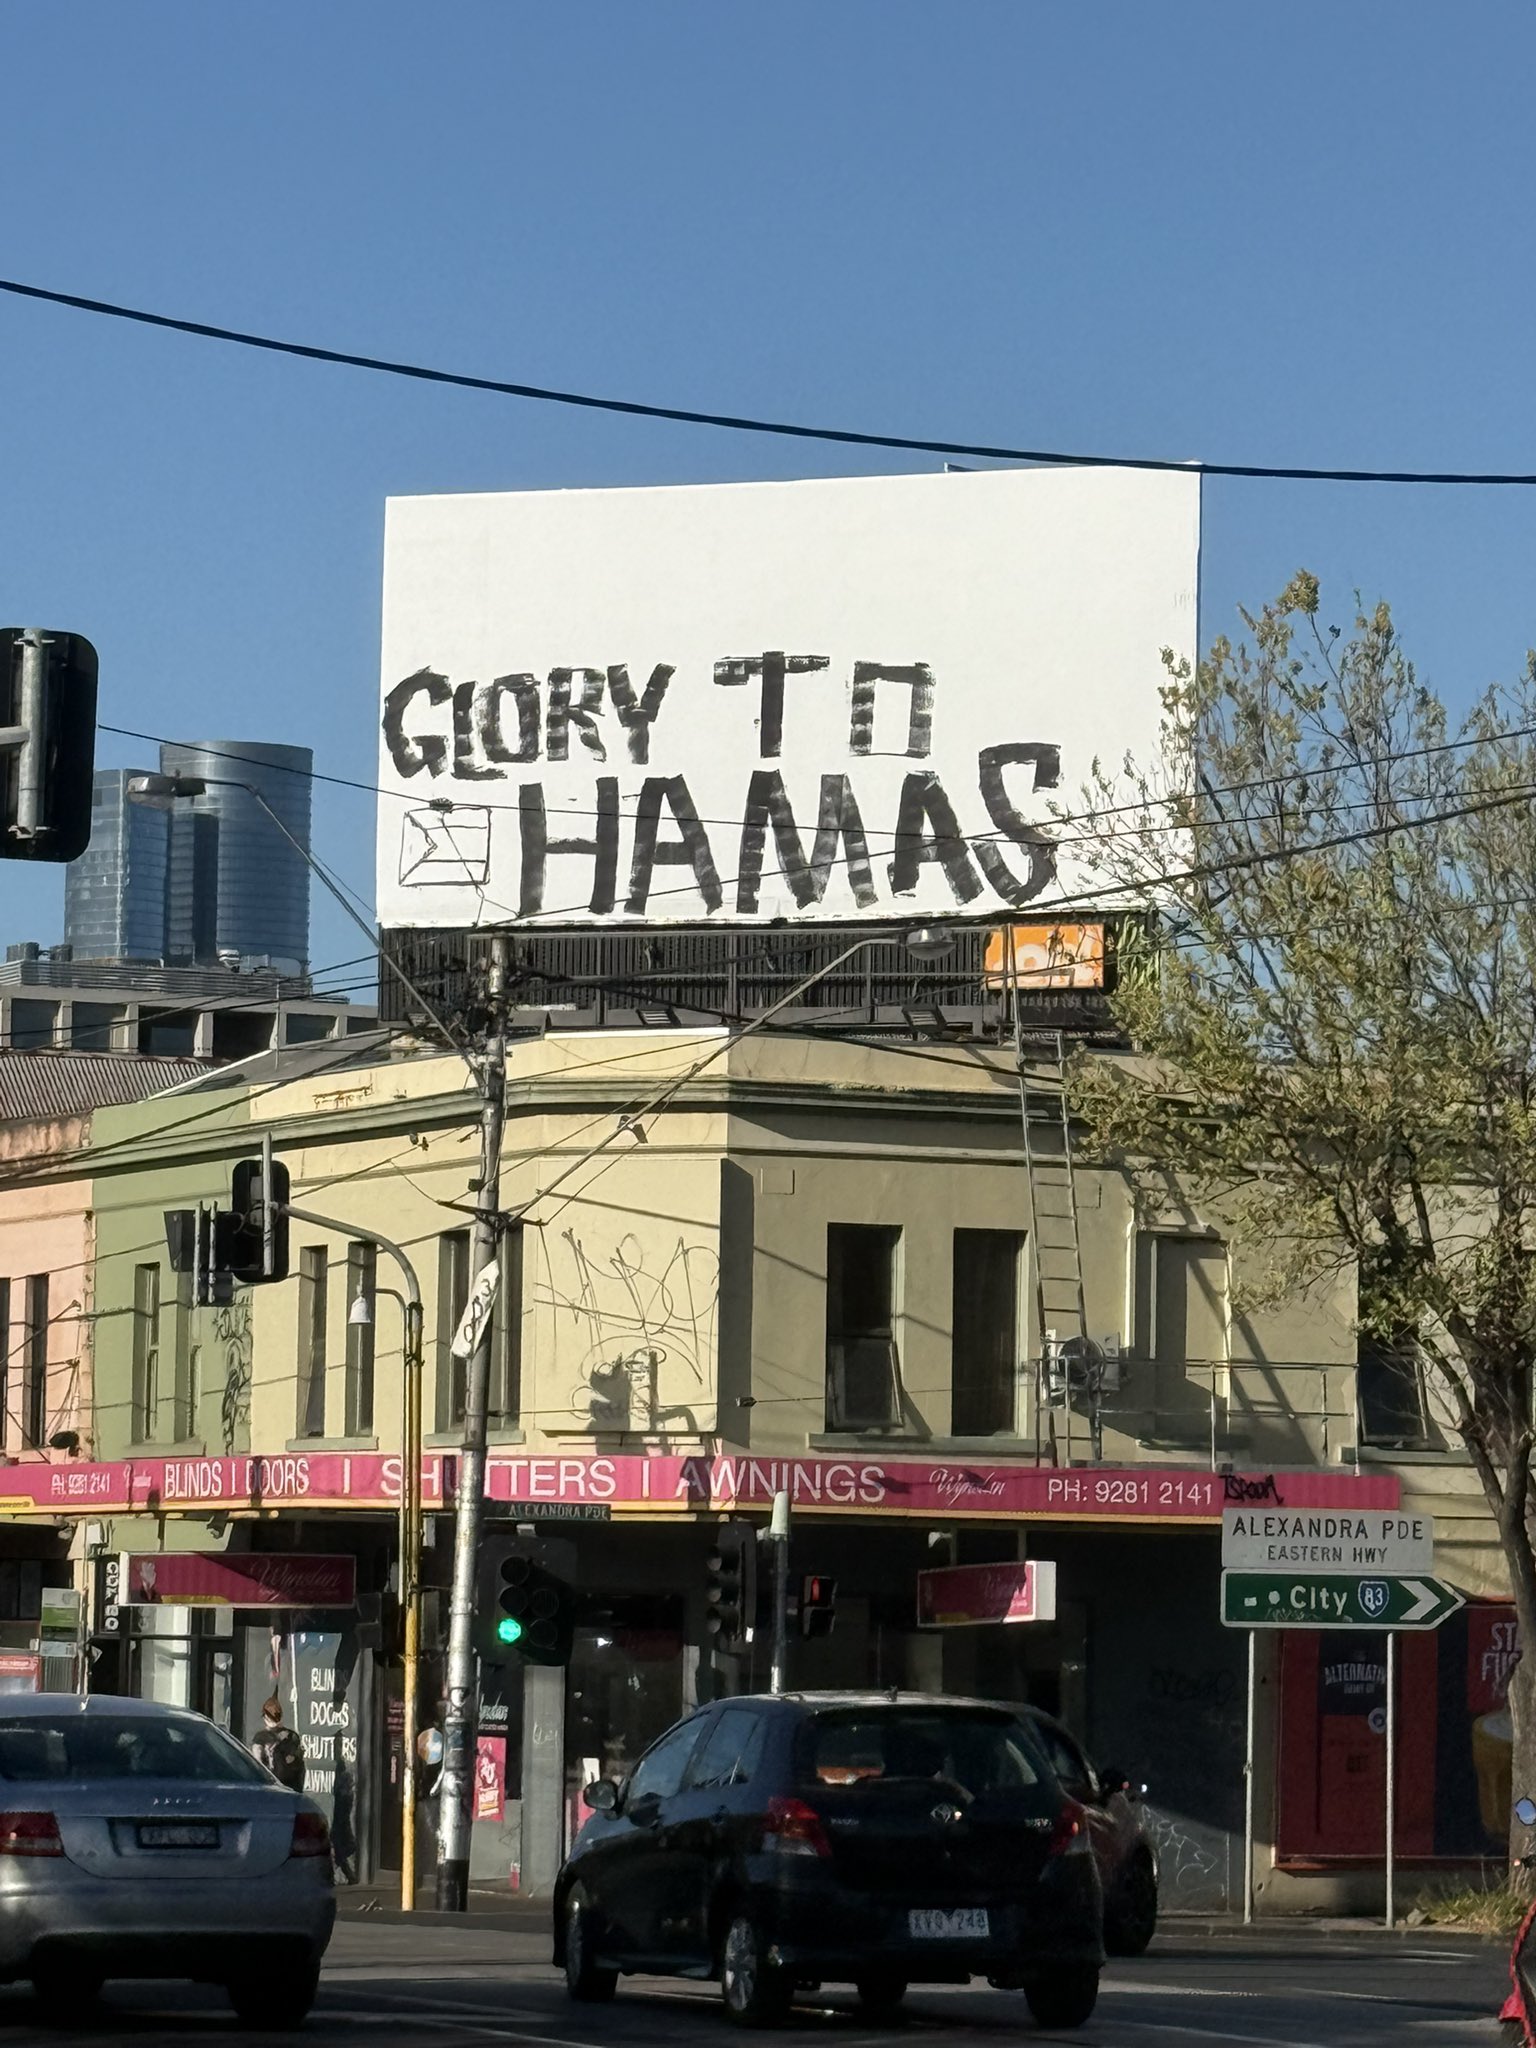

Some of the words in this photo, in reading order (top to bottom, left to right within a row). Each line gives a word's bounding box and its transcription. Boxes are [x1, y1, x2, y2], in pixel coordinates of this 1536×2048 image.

[382, 664, 676, 780] GLORY
[714, 651, 936, 757] TO
[518, 742, 1061, 917] HAMAS
[165, 1461, 222, 1498] BLINDS
[380, 1458, 617, 1497] SHTTERS
[674, 1460, 886, 1502] AWNINGS
[1048, 1478, 1088, 1502] PH:
[1095, 1480, 1149, 1504] 9281
[1159, 1481, 1212, 1505] 2141
[1232, 1515, 1369, 1540] ALEXANDRA
[1382, 1519, 1424, 1541] PDE
[1267, 1545, 1343, 1563] EASTERN
[1353, 1547, 1389, 1564] HWY
[310, 1667, 336, 1692] BLIN
[301, 1734, 357, 1763] SHUTTRS
